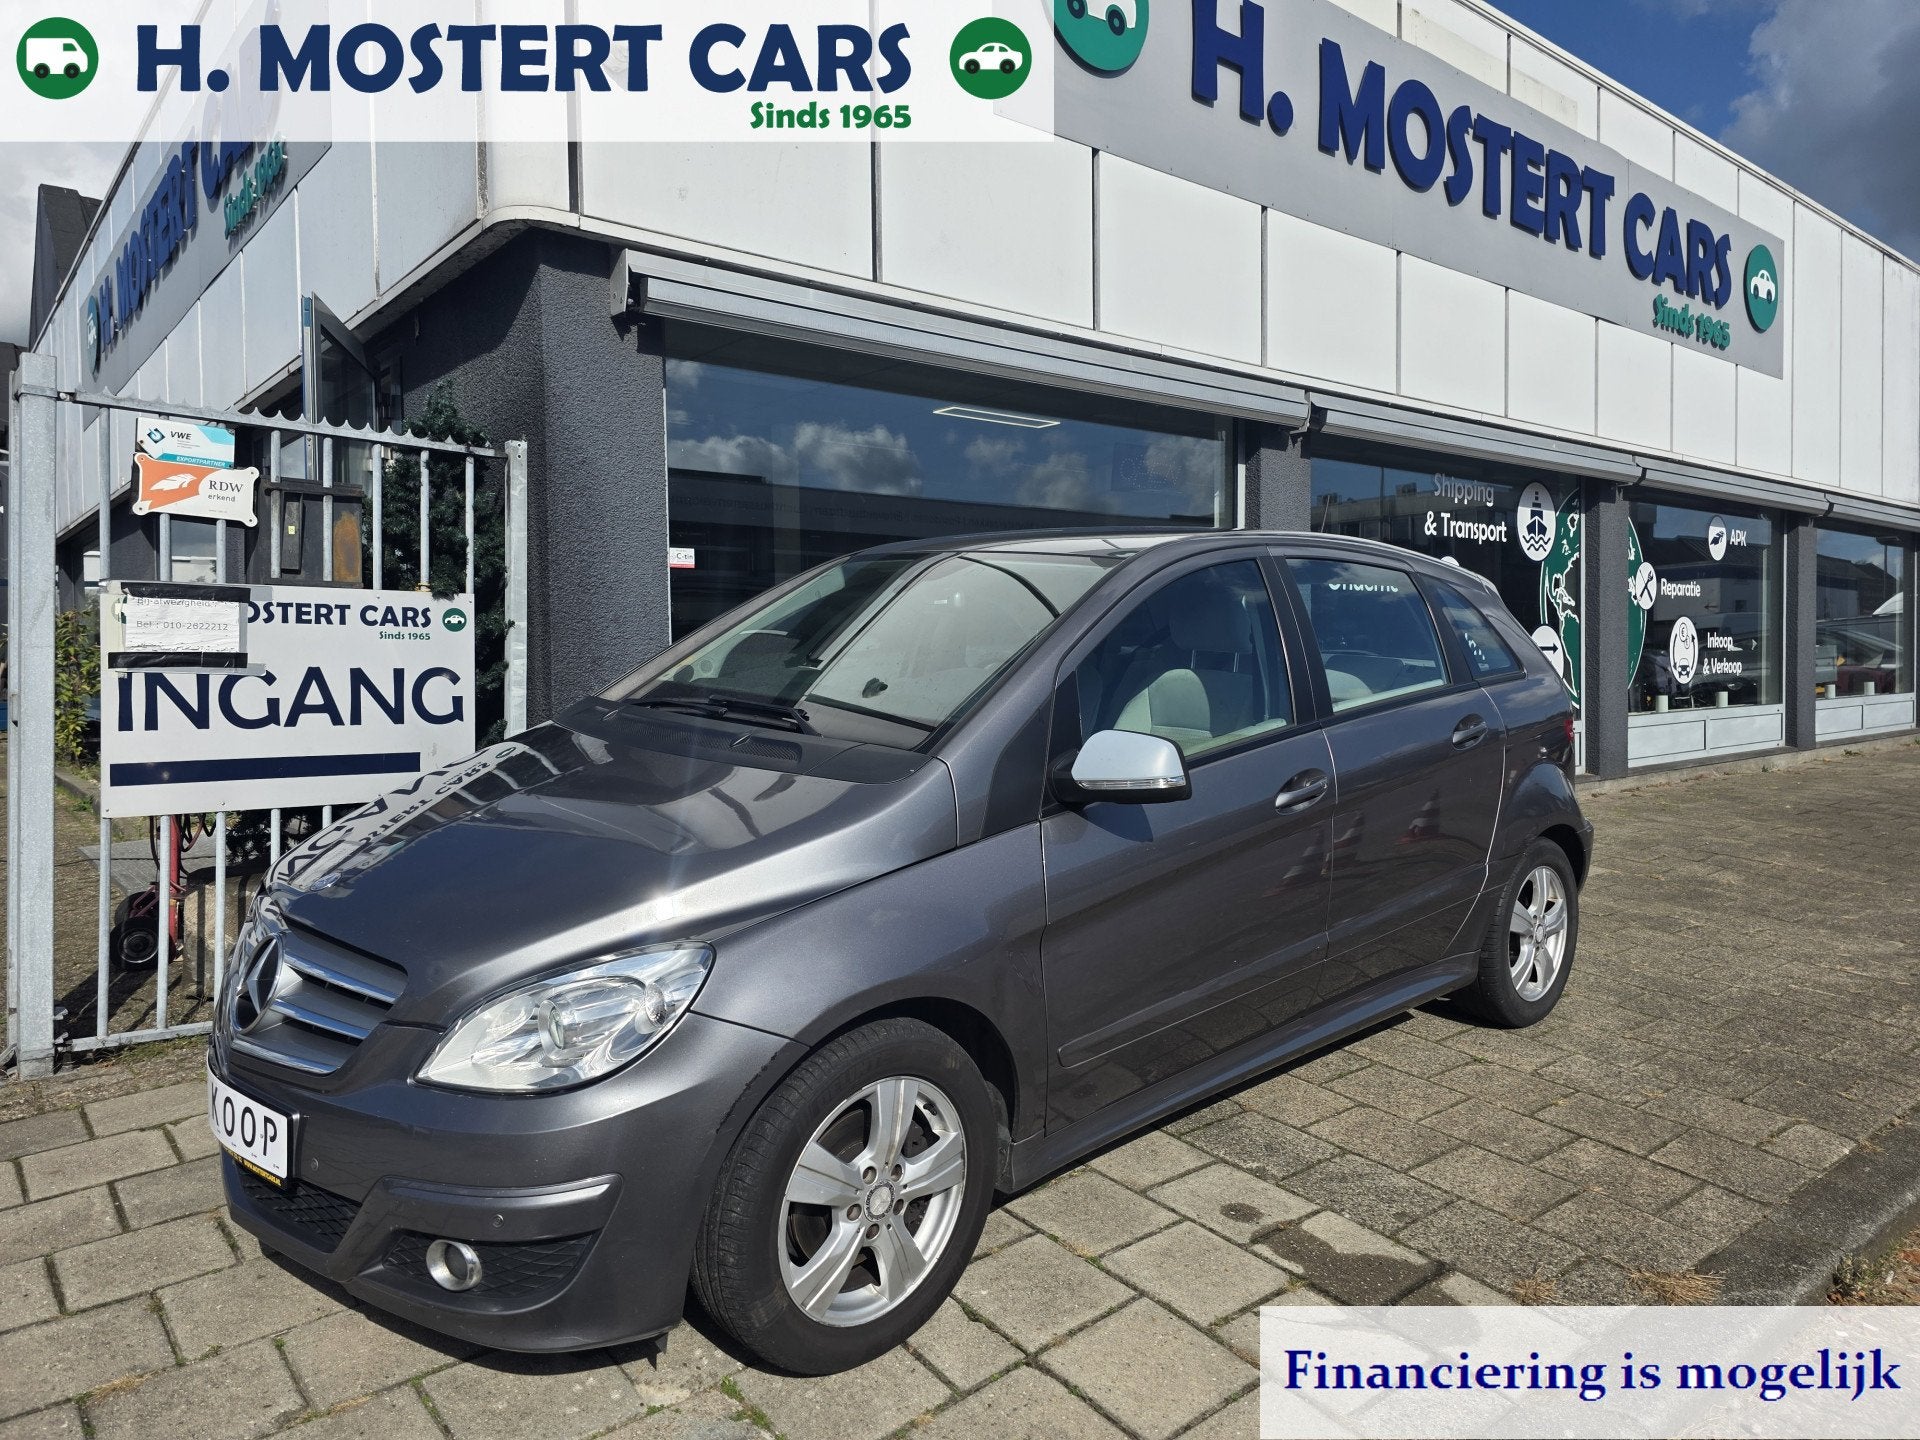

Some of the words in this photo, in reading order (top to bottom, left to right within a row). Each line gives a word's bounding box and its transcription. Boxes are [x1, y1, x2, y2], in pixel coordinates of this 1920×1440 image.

[1192, 0, 1293, 136] H.
[1318, 38, 1614, 260] MOSTERT
[1624, 193, 1731, 309] CARS
[1653, 294, 1695, 338] Sinds
[1696, 313, 1730, 350] 1965
[170, 430, 192, 441] VWE
[176, 456, 226, 468] EXPORTPARTNER
[209, 480, 243, 492] RDW
[1434, 473, 1494, 507] Shipping
[208, 494, 236, 502] erkend
[1424, 511, 1437, 536] &
[1441, 512, 1507, 545] Transport
[1730, 529, 1747, 547] APK
[1661, 577, 1701, 599] Reparatie
[247, 601, 350, 626] OSTERT
[360, 604, 431, 628] CARS
[379, 630, 405, 640] Sinds
[407, 632, 431, 641] 1965
[1707, 632, 1733, 651] Inkoop
[1702, 657, 1711, 675] &
[1711, 657, 1742, 676] Verkoop
[117, 666, 464, 732] INGANG
